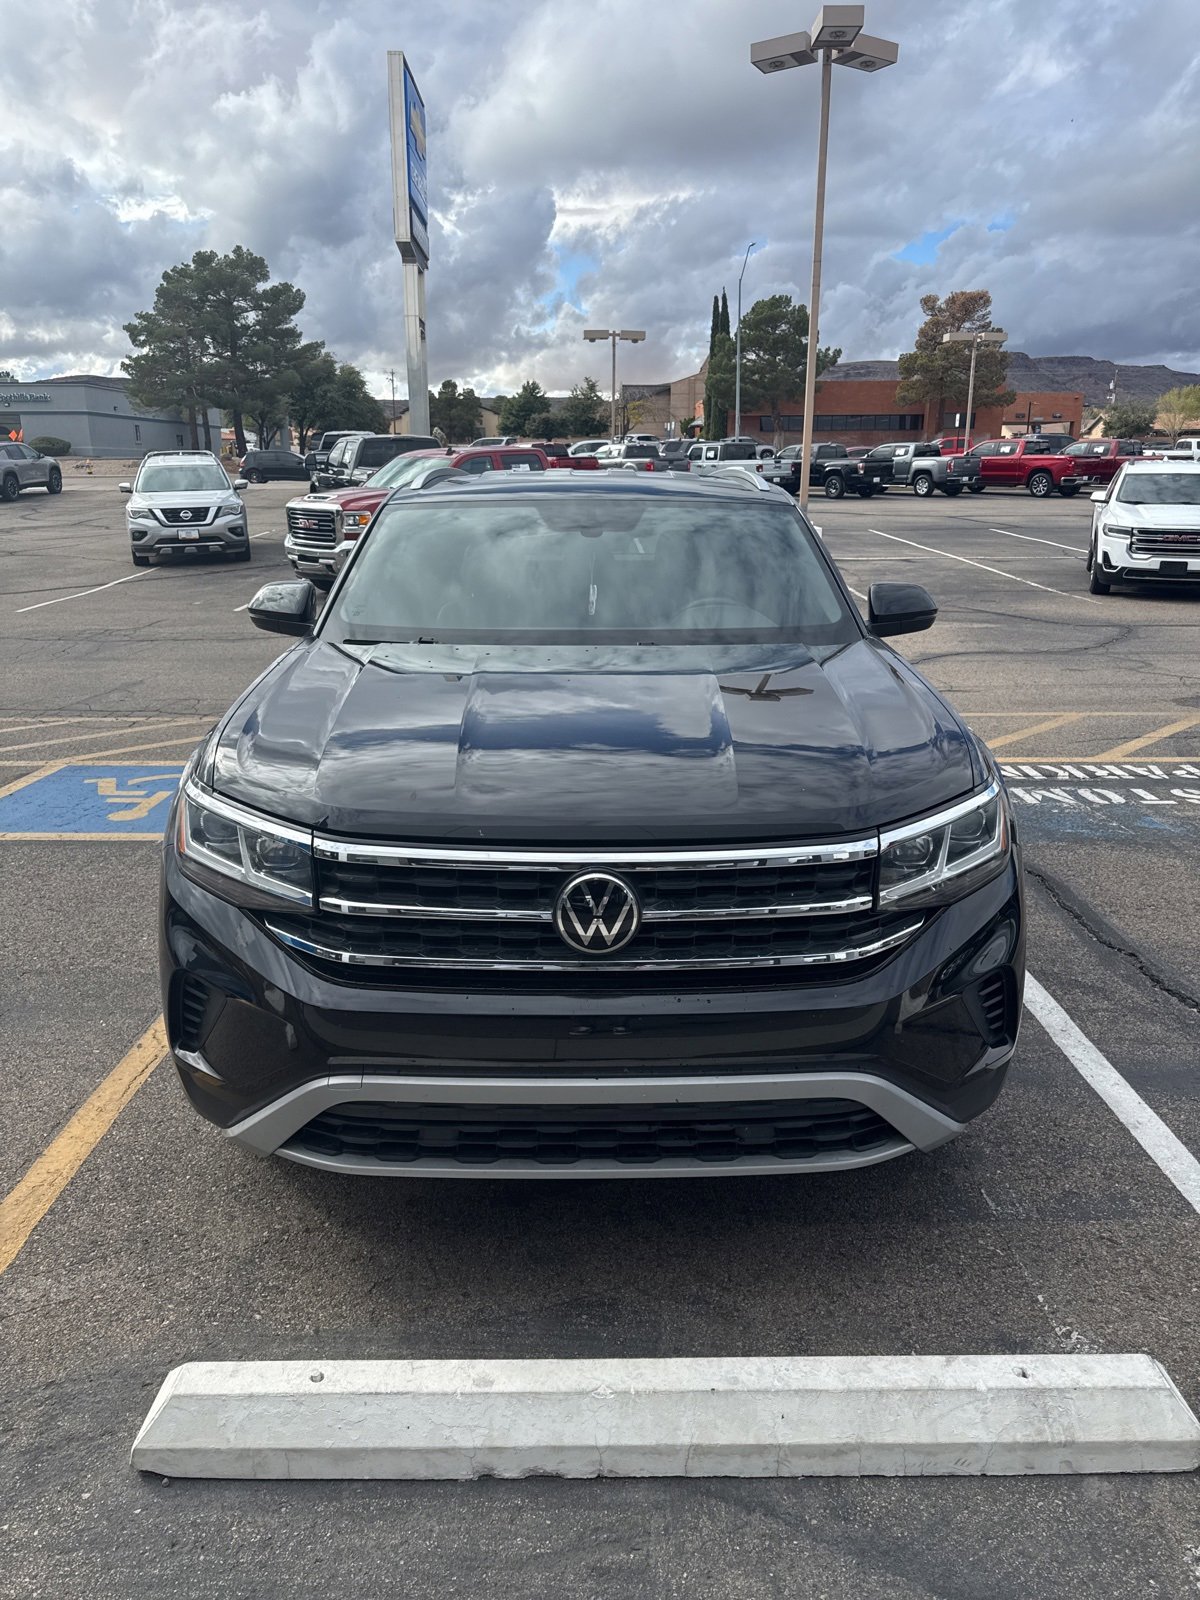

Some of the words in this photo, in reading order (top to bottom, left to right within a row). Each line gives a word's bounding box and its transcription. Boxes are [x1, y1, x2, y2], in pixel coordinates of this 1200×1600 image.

[299, 519, 319, 528] GMC
[1163, 534, 1198, 542] GMC
[560, 876, 636, 949] VW
